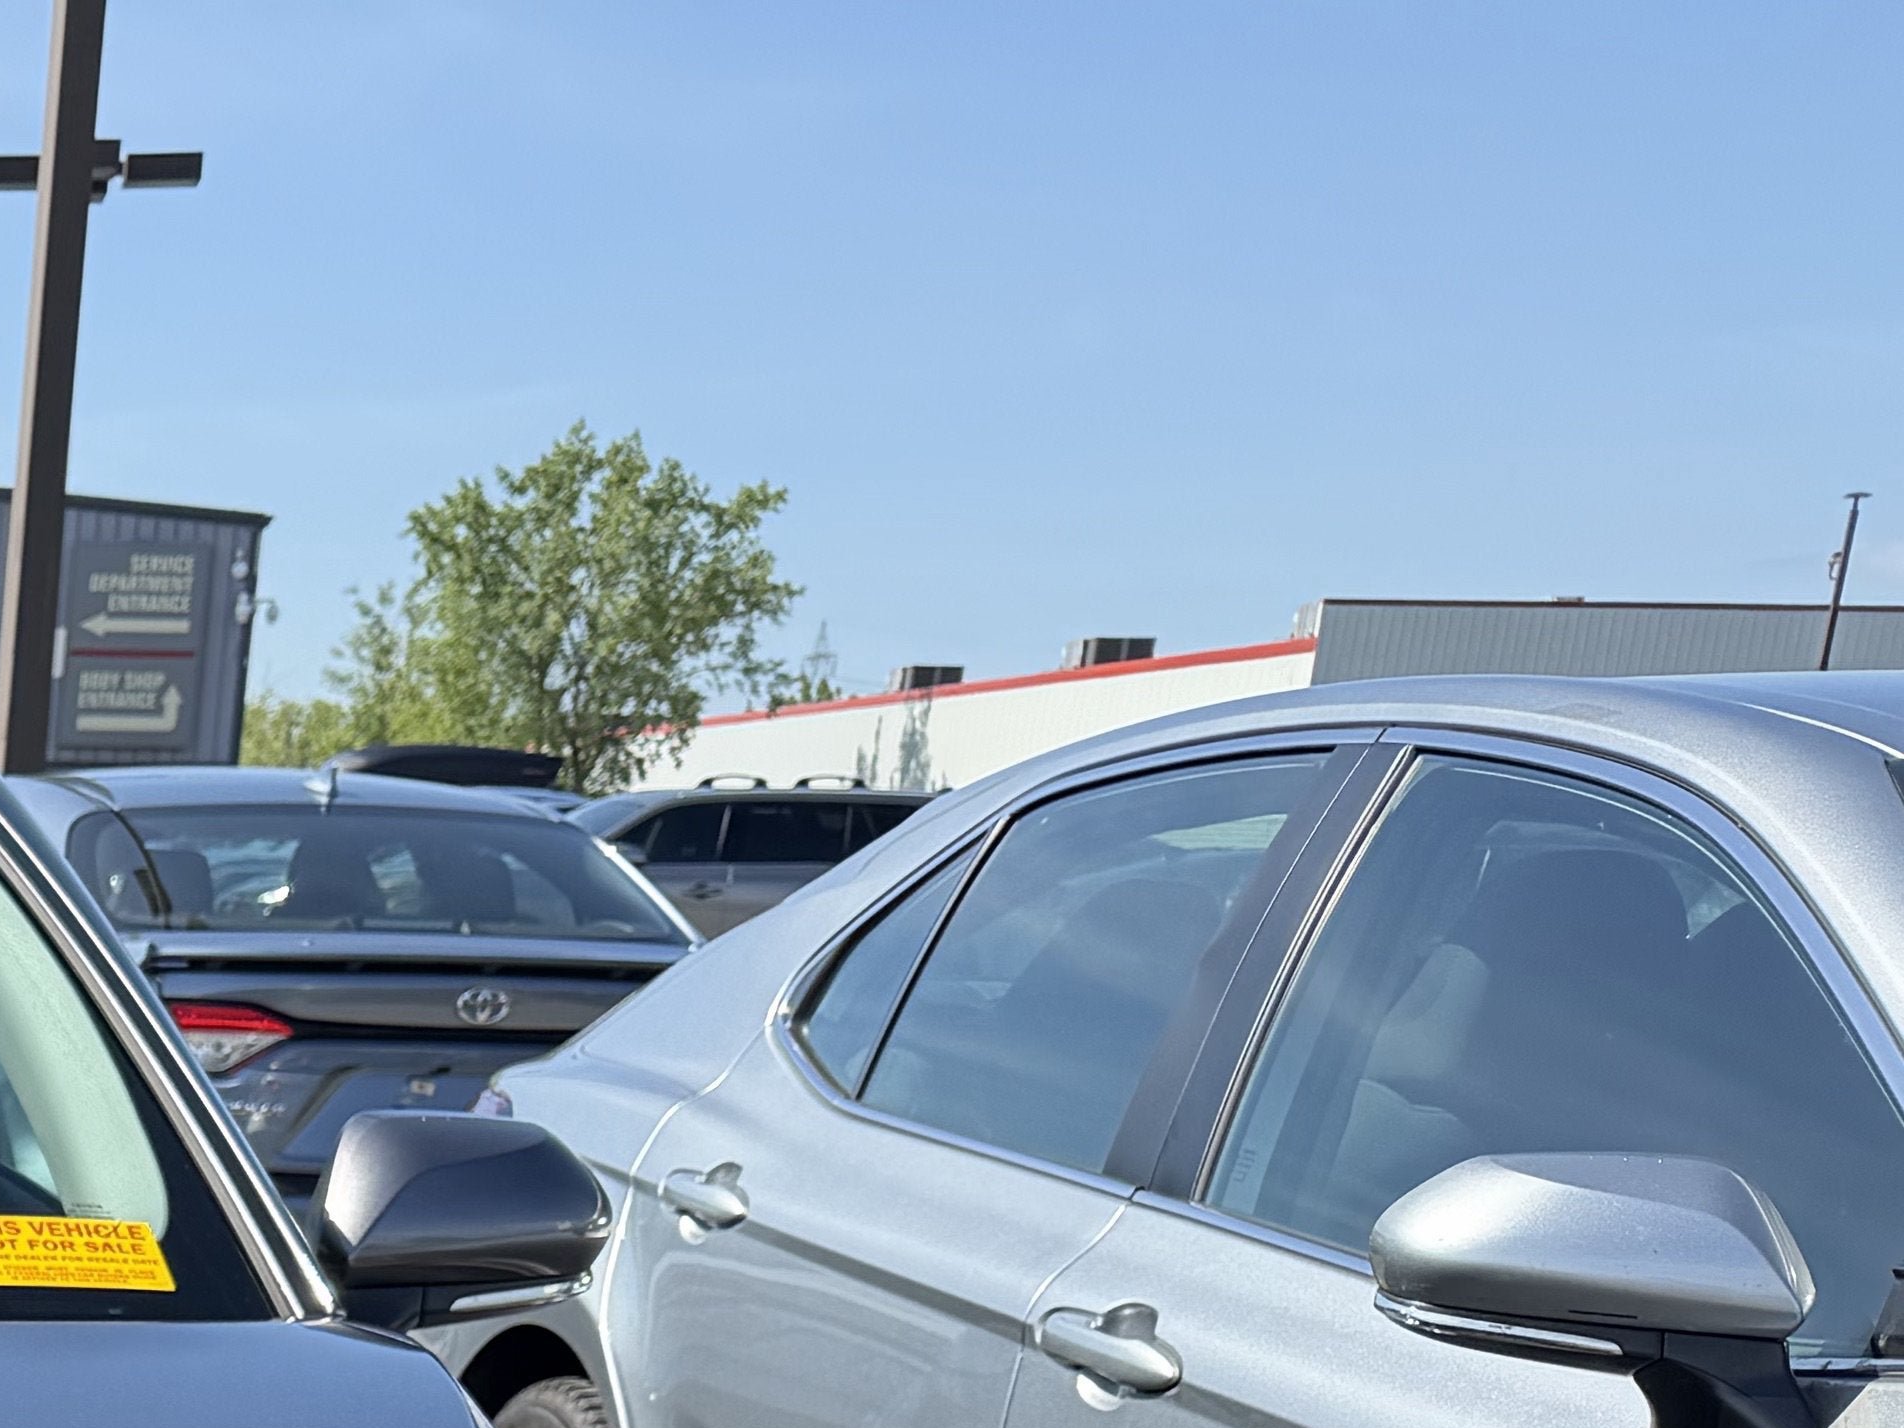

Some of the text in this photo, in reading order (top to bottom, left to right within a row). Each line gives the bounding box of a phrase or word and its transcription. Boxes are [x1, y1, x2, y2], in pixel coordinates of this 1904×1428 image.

[107, 593, 191, 613] ENTRANCE
[77, 690, 159, 710] ENTRANCE
[27, 1220, 146, 1241] VEHICLE
[27, 1239, 77, 1252] FOR
[84, 1241, 146, 1256] SALE
